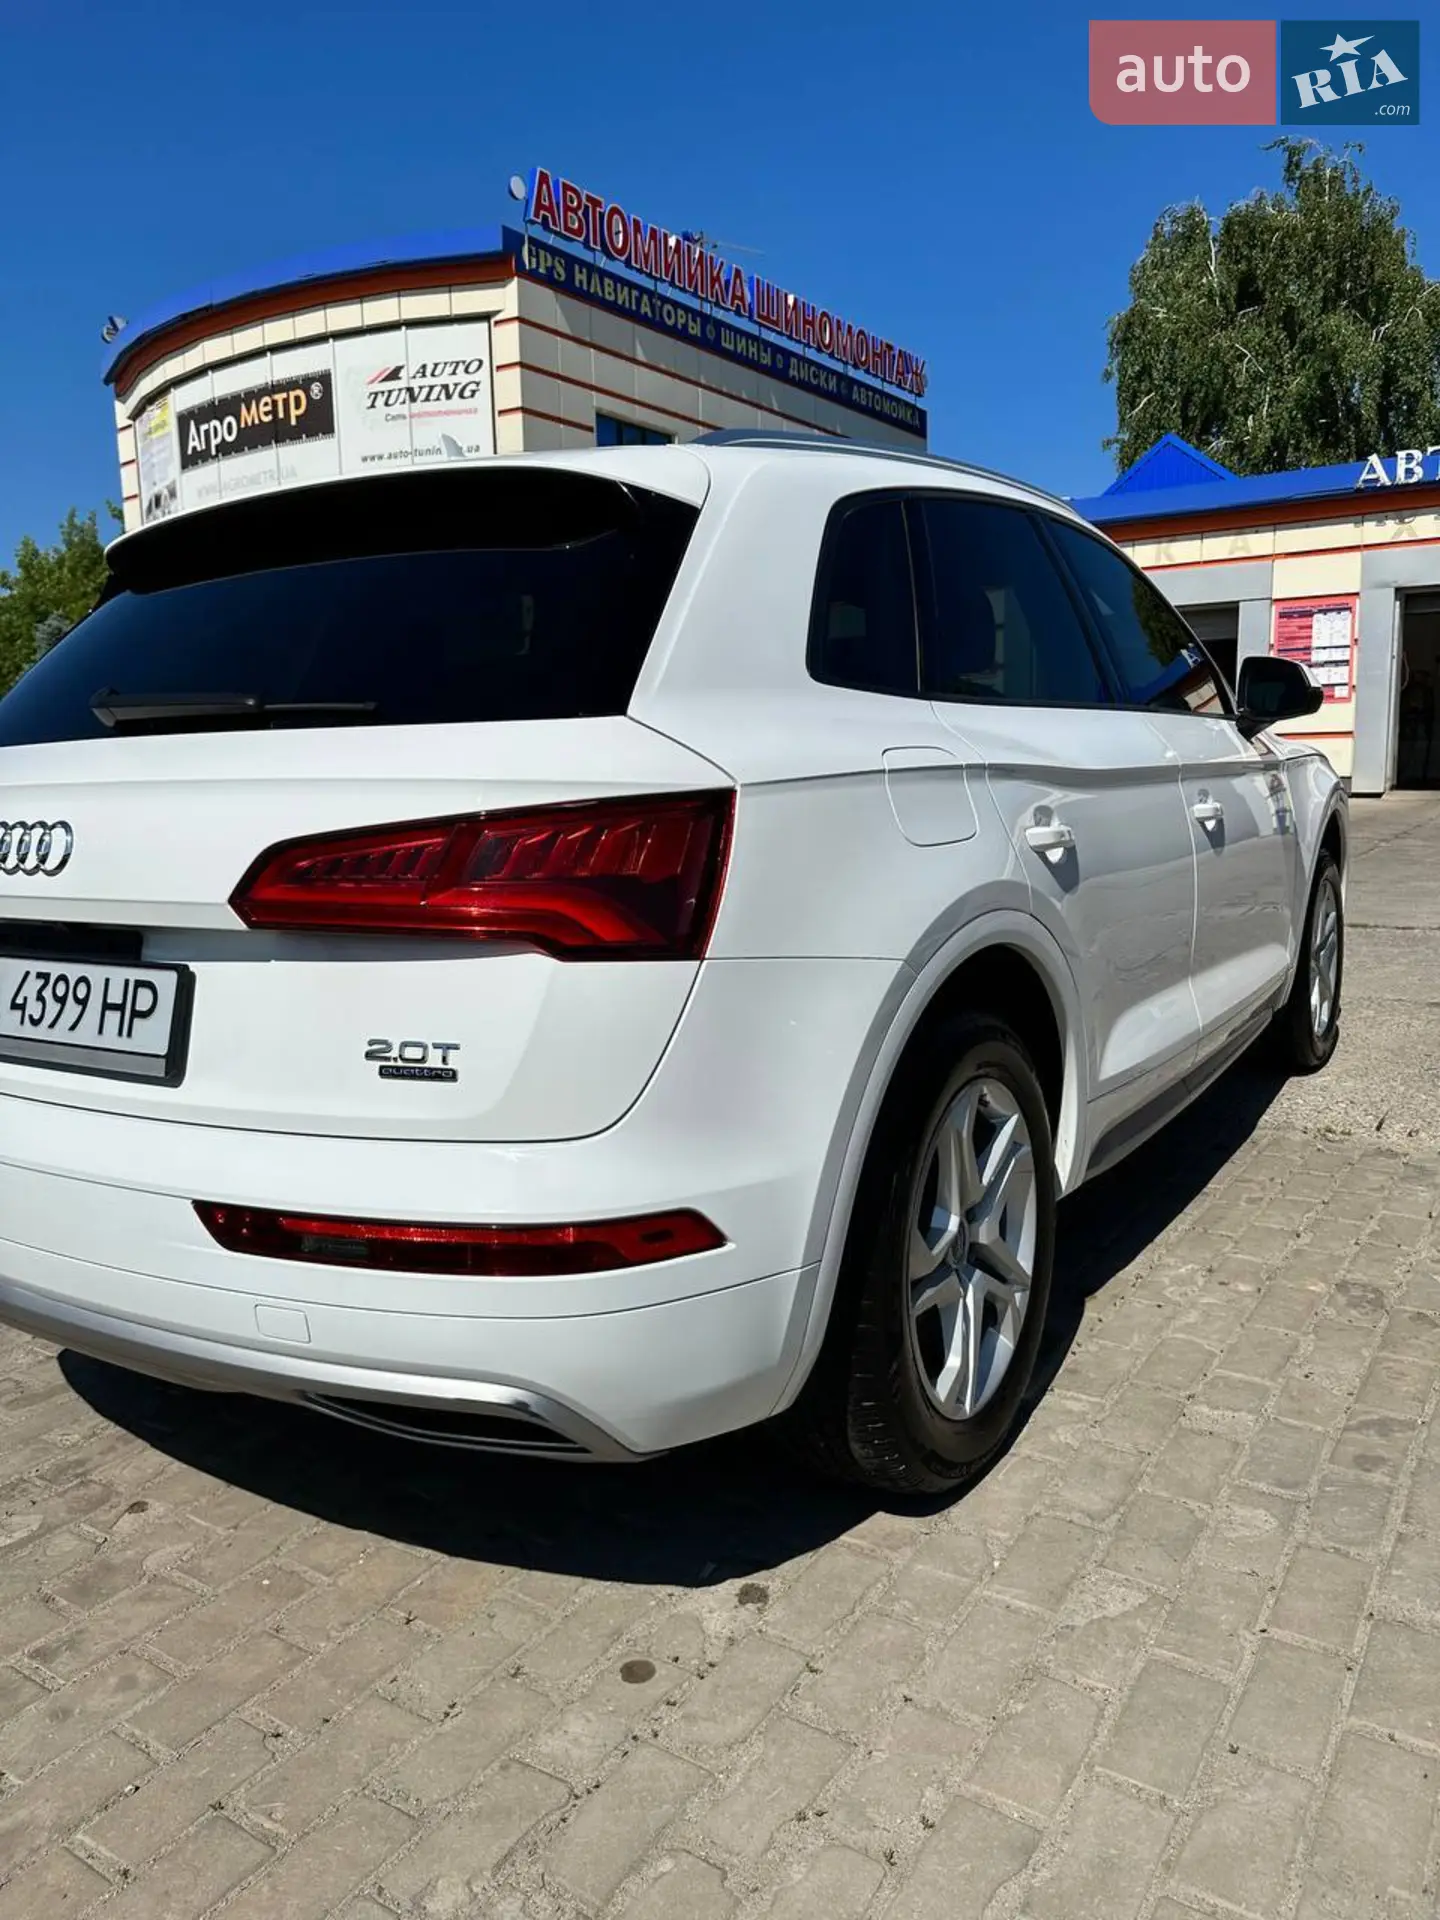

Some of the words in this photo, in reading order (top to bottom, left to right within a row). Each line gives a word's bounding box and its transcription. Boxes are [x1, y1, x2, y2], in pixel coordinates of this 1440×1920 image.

[522, 242, 567, 282] GPS
[574, 263, 702, 337] НАВИГАТОРЫ
[720, 326, 772, 368] ШИНЫ
[788, 356, 837, 392] ДИСКИ
[752, 275, 926, 397] ШИНОМОНТАЖ
[411, 358, 483, 379] AUTO
[366, 381, 481, 410] TUNING
[187, 415, 238, 456] Агро
[239, 388, 308, 426] метр
[9, 969, 92, 1031] 4399
[364, 1038, 461, 1065] 2.0T
[380, 1066, 454, 1078] quattro
